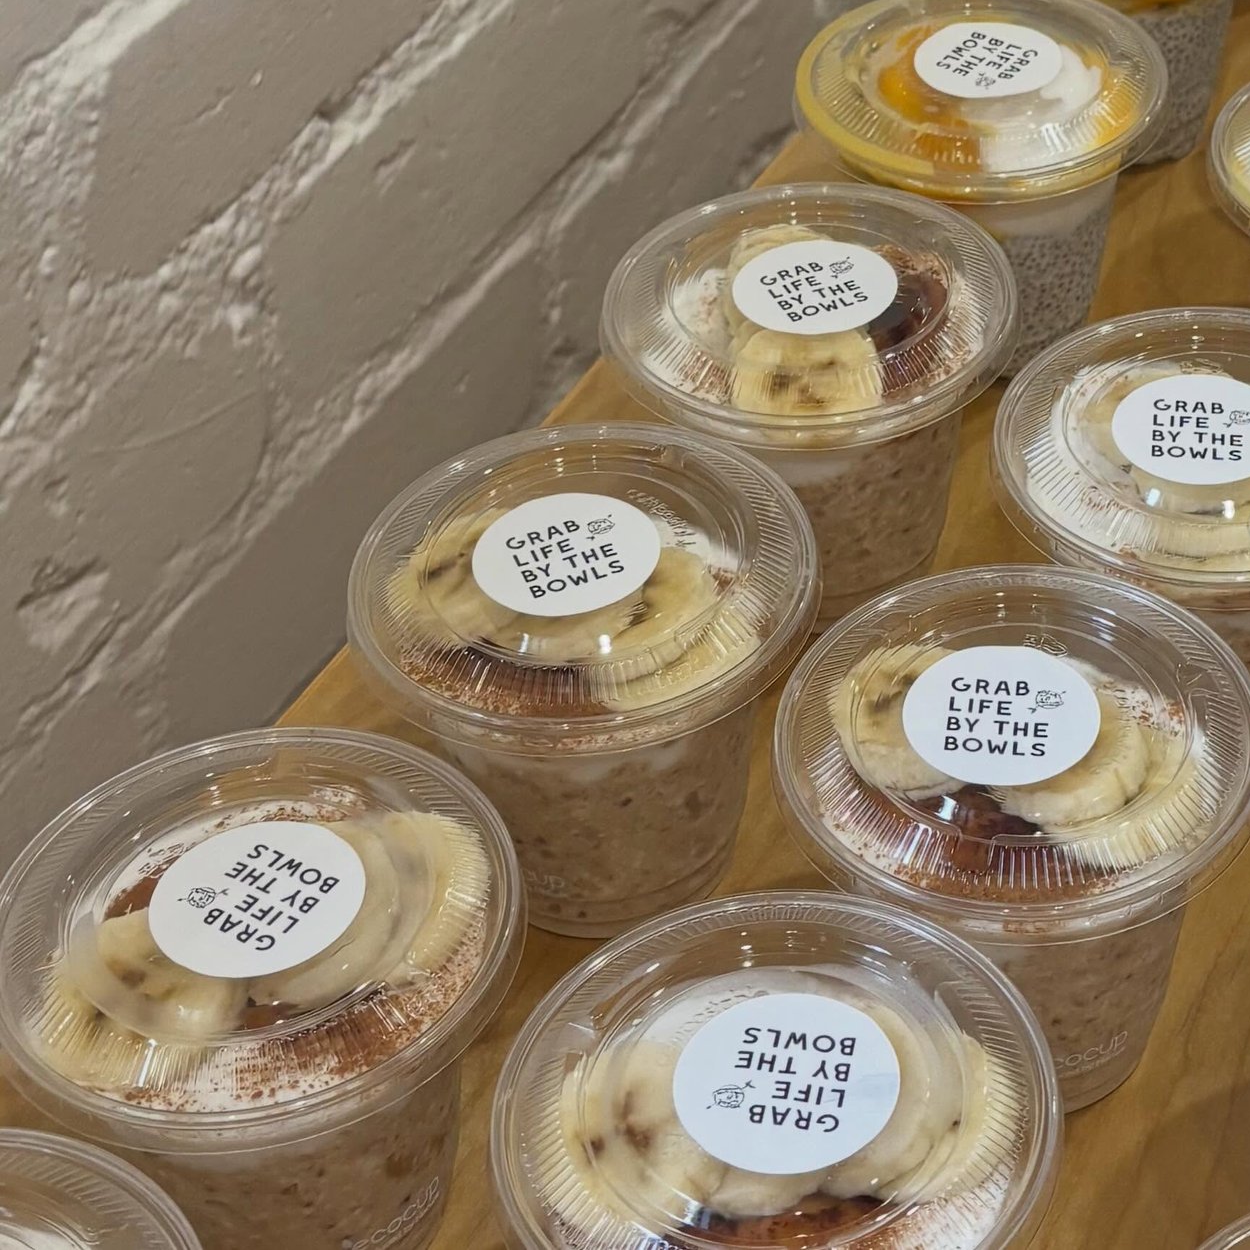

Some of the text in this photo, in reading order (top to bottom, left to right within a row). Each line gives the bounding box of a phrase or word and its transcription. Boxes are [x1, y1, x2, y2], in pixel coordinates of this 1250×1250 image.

[936, 31, 986, 70] BOWLS
[953, 37, 1004, 76] BY THE
[989, 43, 1022, 73] LIFE
[998, 50, 1038, 80] GRAB
[760, 261, 824, 286] GRAB
[768, 276, 821, 298] LIFE
[777, 280, 861, 311] BY THE
[787, 292, 868, 322] BOWLS
[1153, 399, 1224, 415] GRAB
[1153, 415, 1209, 428] LIFE
[1151, 445, 1243, 461] BOWLS
[1152, 430, 1243, 447] BY THE
[505, 519, 581, 549] GRAB
[513, 539, 575, 567] LIFE
[522, 542, 620, 583] BY THE
[529, 560, 625, 599] BOWLS
[951, 676, 1030, 696] GRAB
[949, 696, 1013, 716] LIFE
[946, 717, 1049, 739] BY THE
[944, 736, 1046, 757] BOWLS
[247, 843, 340, 894] BOWLS
[225, 861, 320, 915] BY THE
[236, 893, 300, 934] LIFE
[203, 909, 276, 952] GRAB
[742, 1026, 856, 1056] BOWLS
[734, 1050, 851, 1082] BY THE
[771, 1080, 845, 1108] LIFE
[748, 1103, 840, 1133] GRAB
